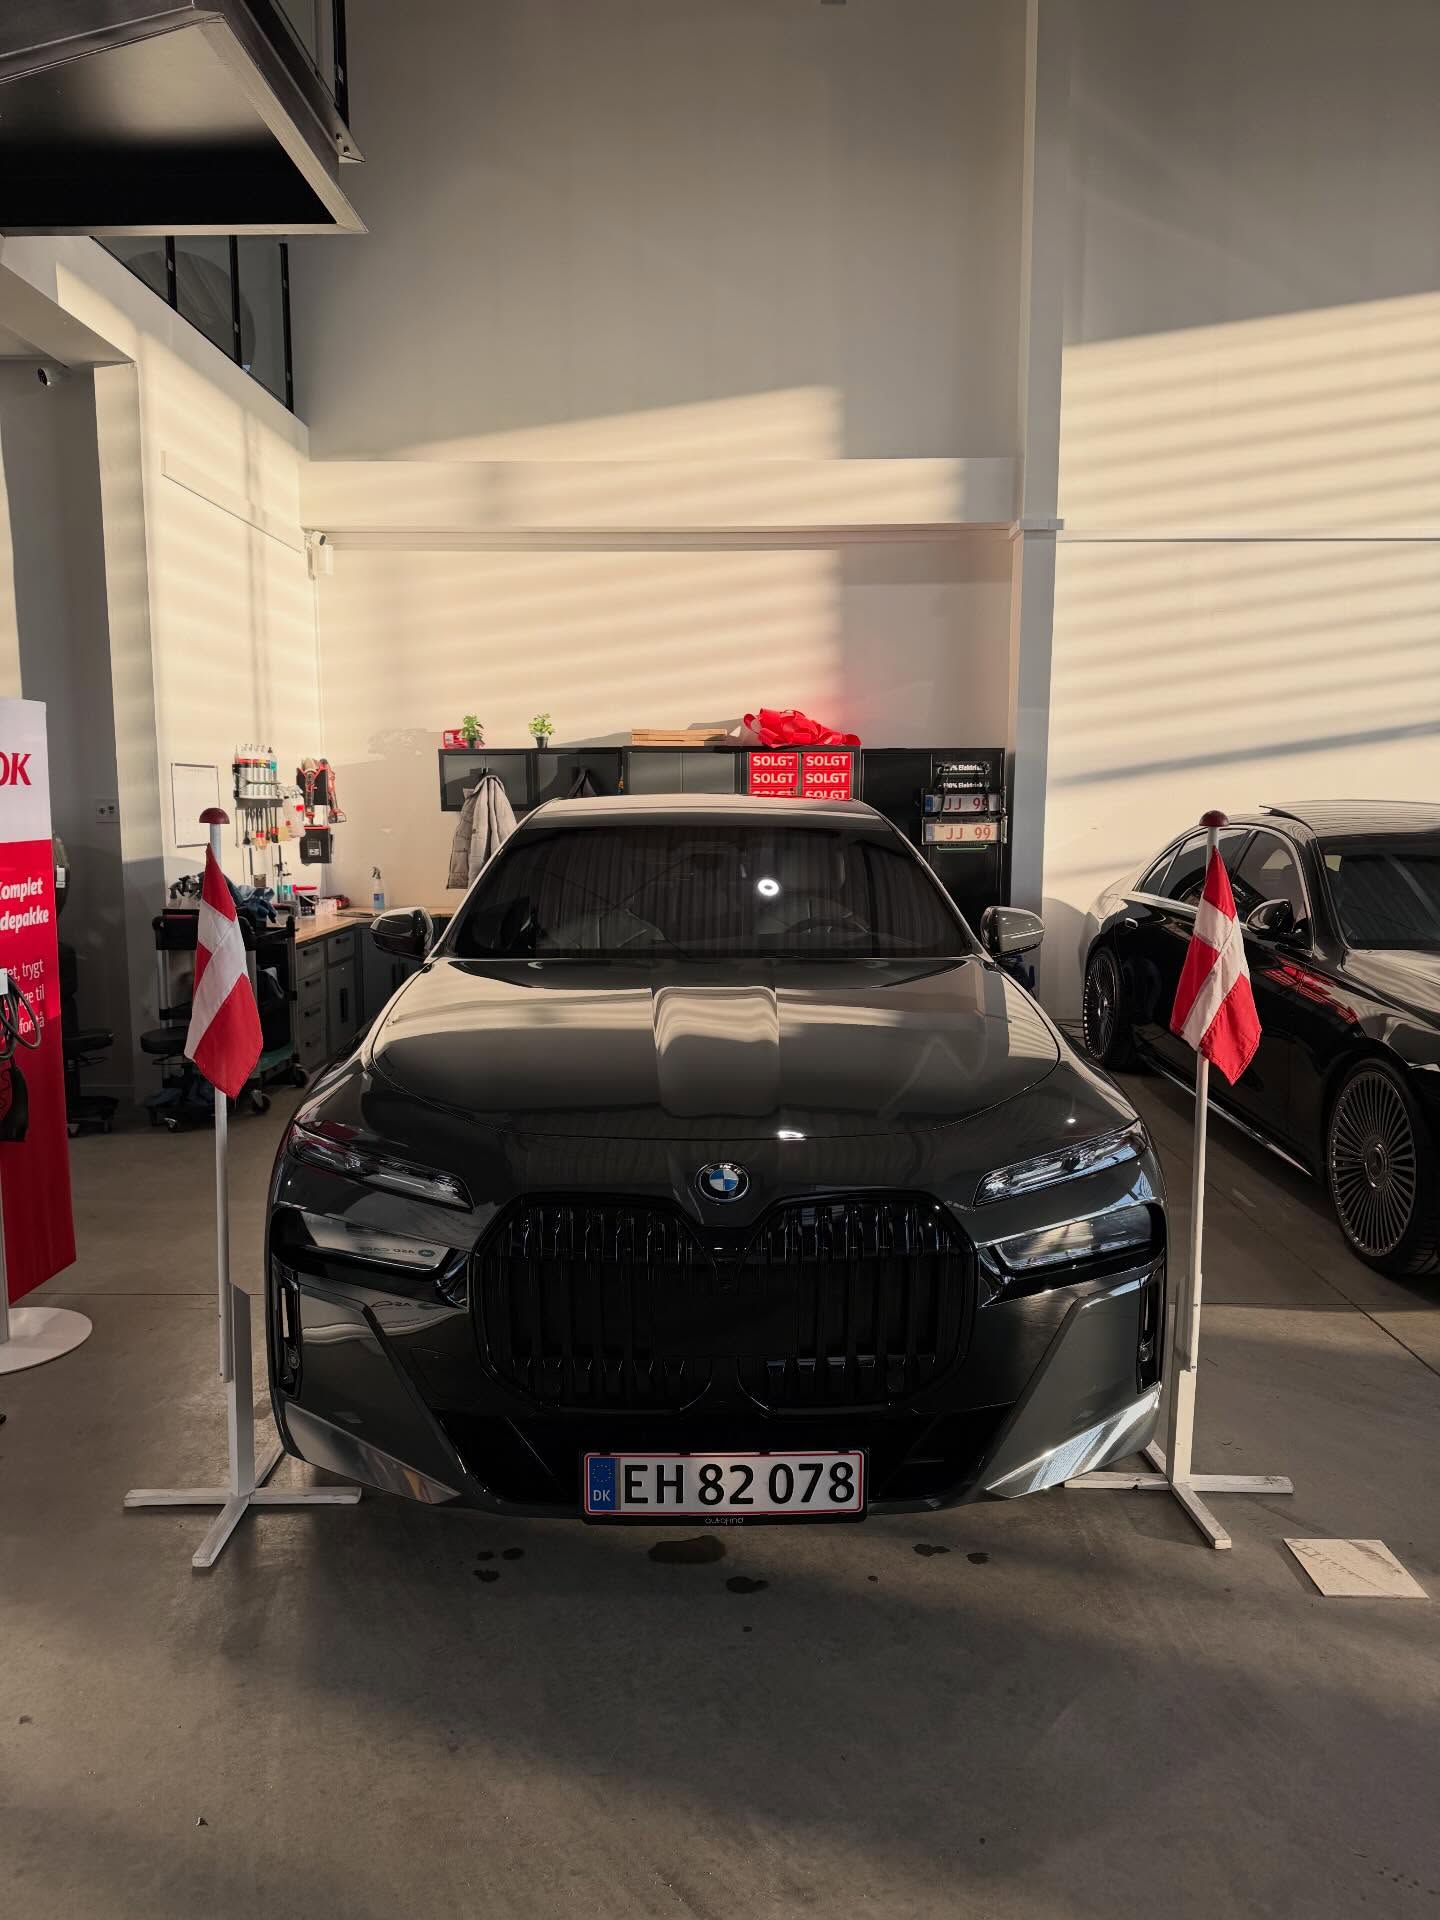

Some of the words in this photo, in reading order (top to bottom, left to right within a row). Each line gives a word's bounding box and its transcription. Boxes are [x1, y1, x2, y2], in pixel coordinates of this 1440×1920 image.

[753, 756, 795, 766] SOLGT
[806, 756, 848, 766] SOLGT
[753, 773, 795, 783] SOLGT
[806, 773, 848, 783] SOLGT
[944, 798, 962, 810] JJ
[946, 827, 963, 840] JJ
[974, 826, 992, 840] 99
[0, 905, 49, 933] depakke
[22, 959, 44, 980] trygt
[36, 984, 45, 1001] til
[624, 1464, 684, 1504] EH
[698, 1463, 754, 1505] 82
[768, 1462, 855, 1504] 078
[593, 1489, 611, 1502] DK
